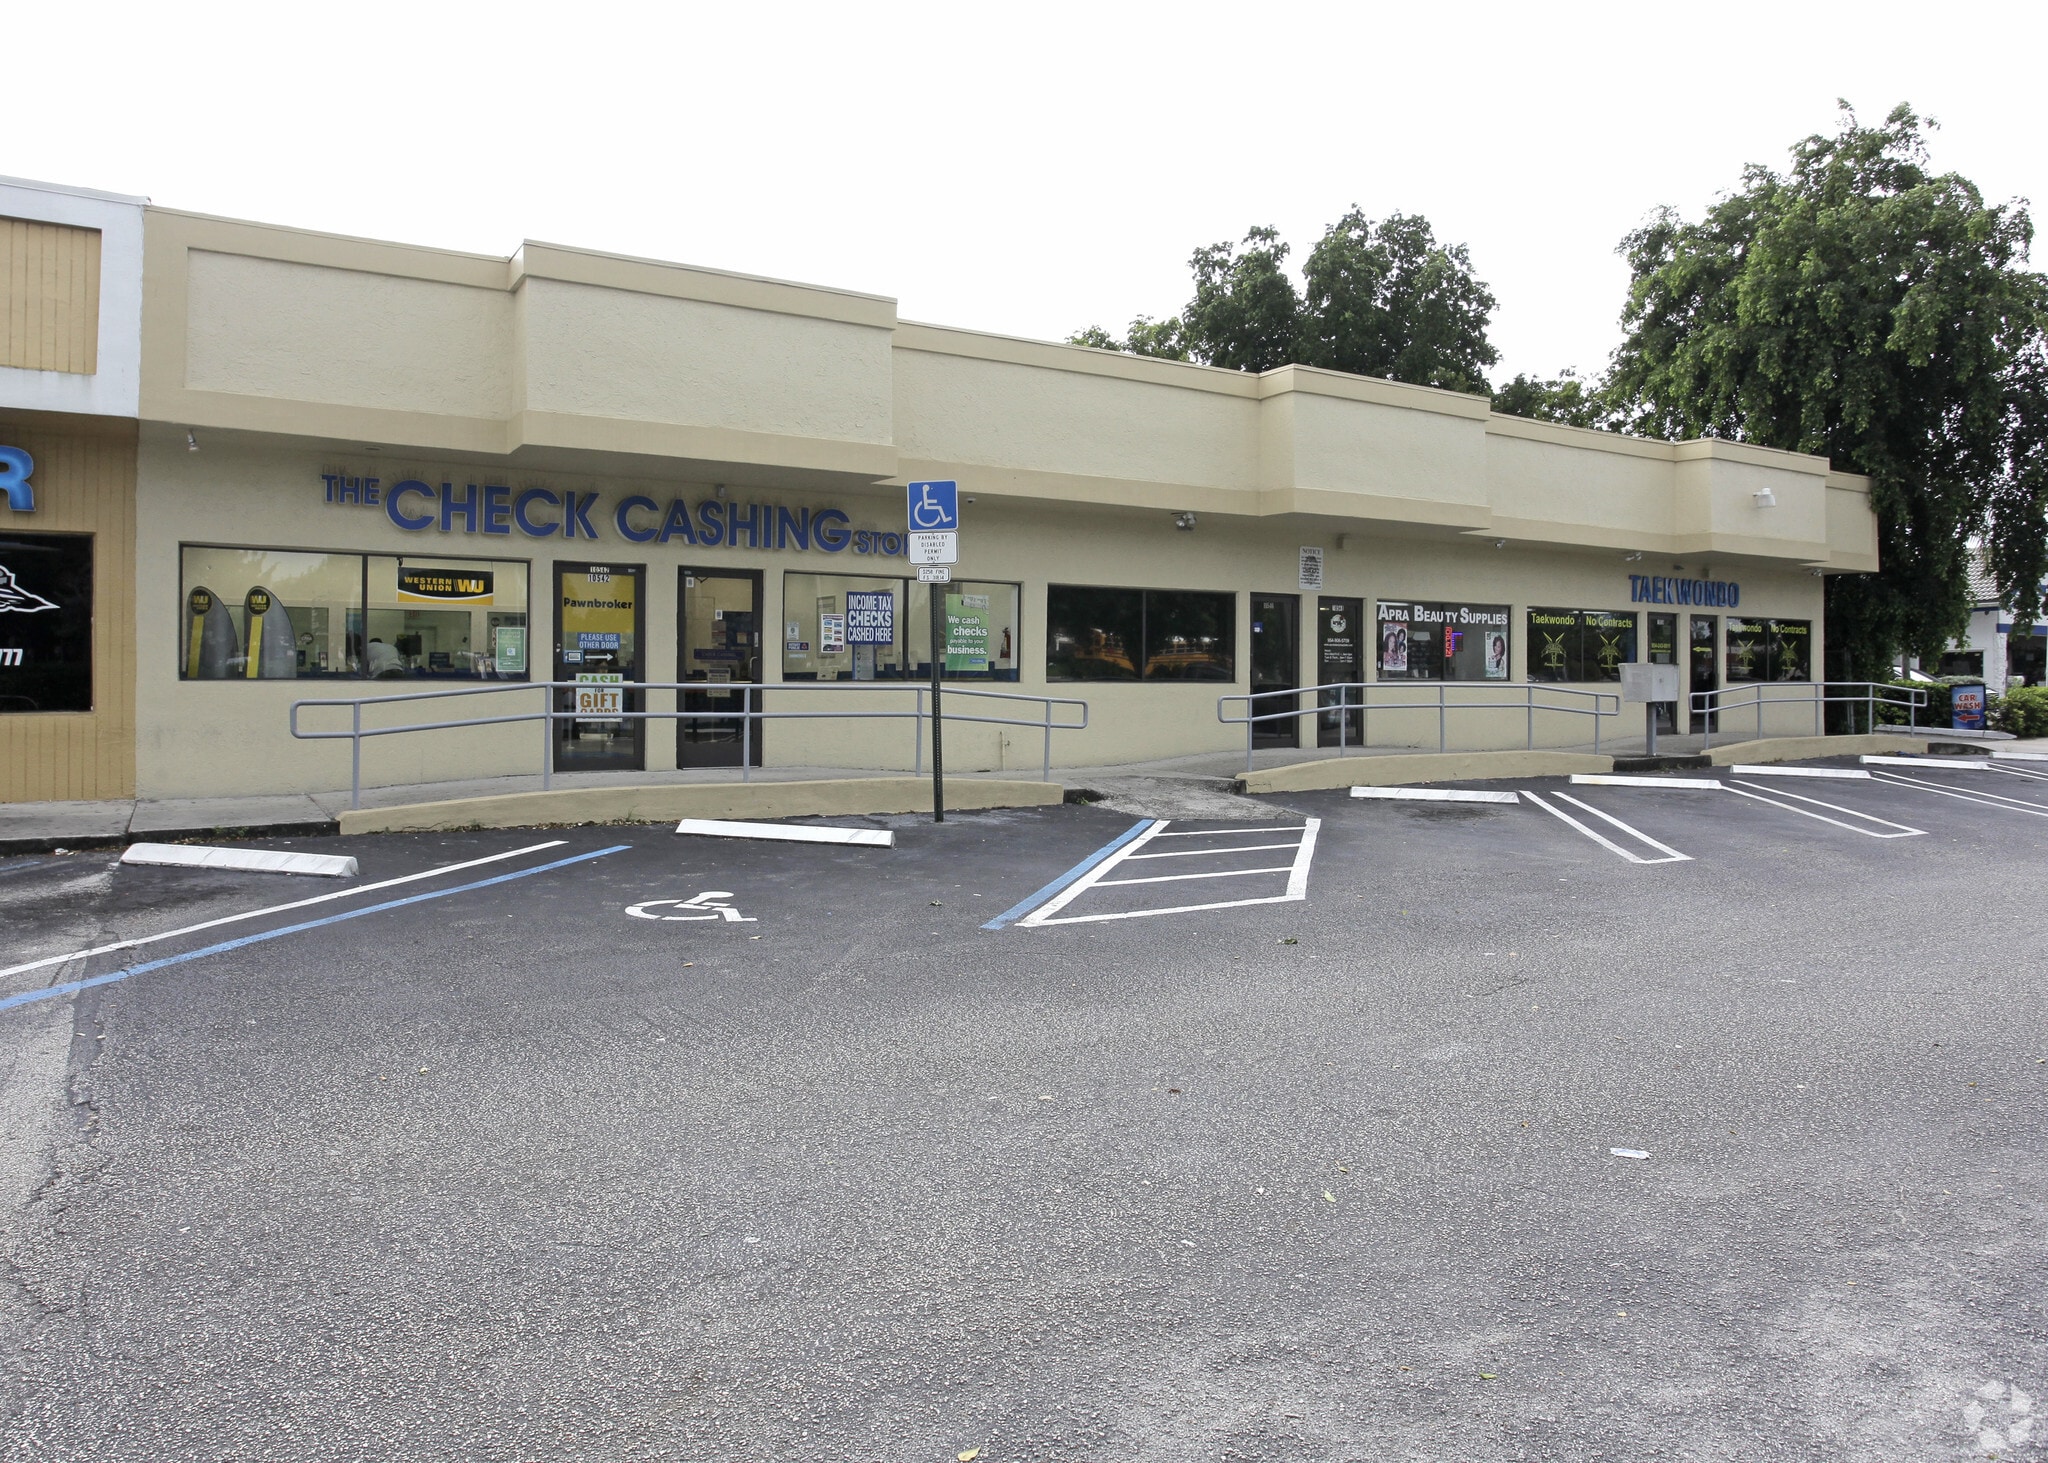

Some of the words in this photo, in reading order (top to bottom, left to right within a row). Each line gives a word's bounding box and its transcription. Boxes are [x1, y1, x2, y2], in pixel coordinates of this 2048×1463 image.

[320, 473, 381, 506] THE
[385, 479, 600, 539] CHECK
[614, 495, 852, 553] CASHING
[854, 529, 909, 556] STO
[404, 576, 452, 585] WESTERN
[587, 574, 610, 582] 10542
[419, 583, 452, 592] UNION
[457, 579, 485, 593] WU
[1628, 574, 1740, 608] TAEKWONDO
[563, 597, 633, 609] Pawnbroker
[848, 594, 877, 610] INCOME
[878, 596, 893, 611] TAX
[847, 610, 892, 627] CHECKS
[947, 615, 960, 624] We
[1460, 607, 1508, 625] SUPPLIES
[1531, 613, 1575, 625] Taekwondo
[1585, 616, 1597, 626] No
[1598, 616, 1633, 628] Contracts
[953, 626, 988, 636] checks
[1728, 621, 1763, 633] Taekwondo
[1770, 624, 1779, 633] No
[1780, 624, 1808, 635] Contracts
[580, 633, 604, 641] PLEASE
[604, 633, 618, 641] USE
[847, 627, 874, 641] CASHED
[875, 627, 892, 642] HERE
[579, 641, 600, 649] OTHER
[600, 641, 619, 649] DOOR
[947, 645, 987, 655] business.
[580, 692, 619, 708] GIFT
[1958, 693, 1977, 702] CAR
[1954, 702, 1982, 710] WASH
